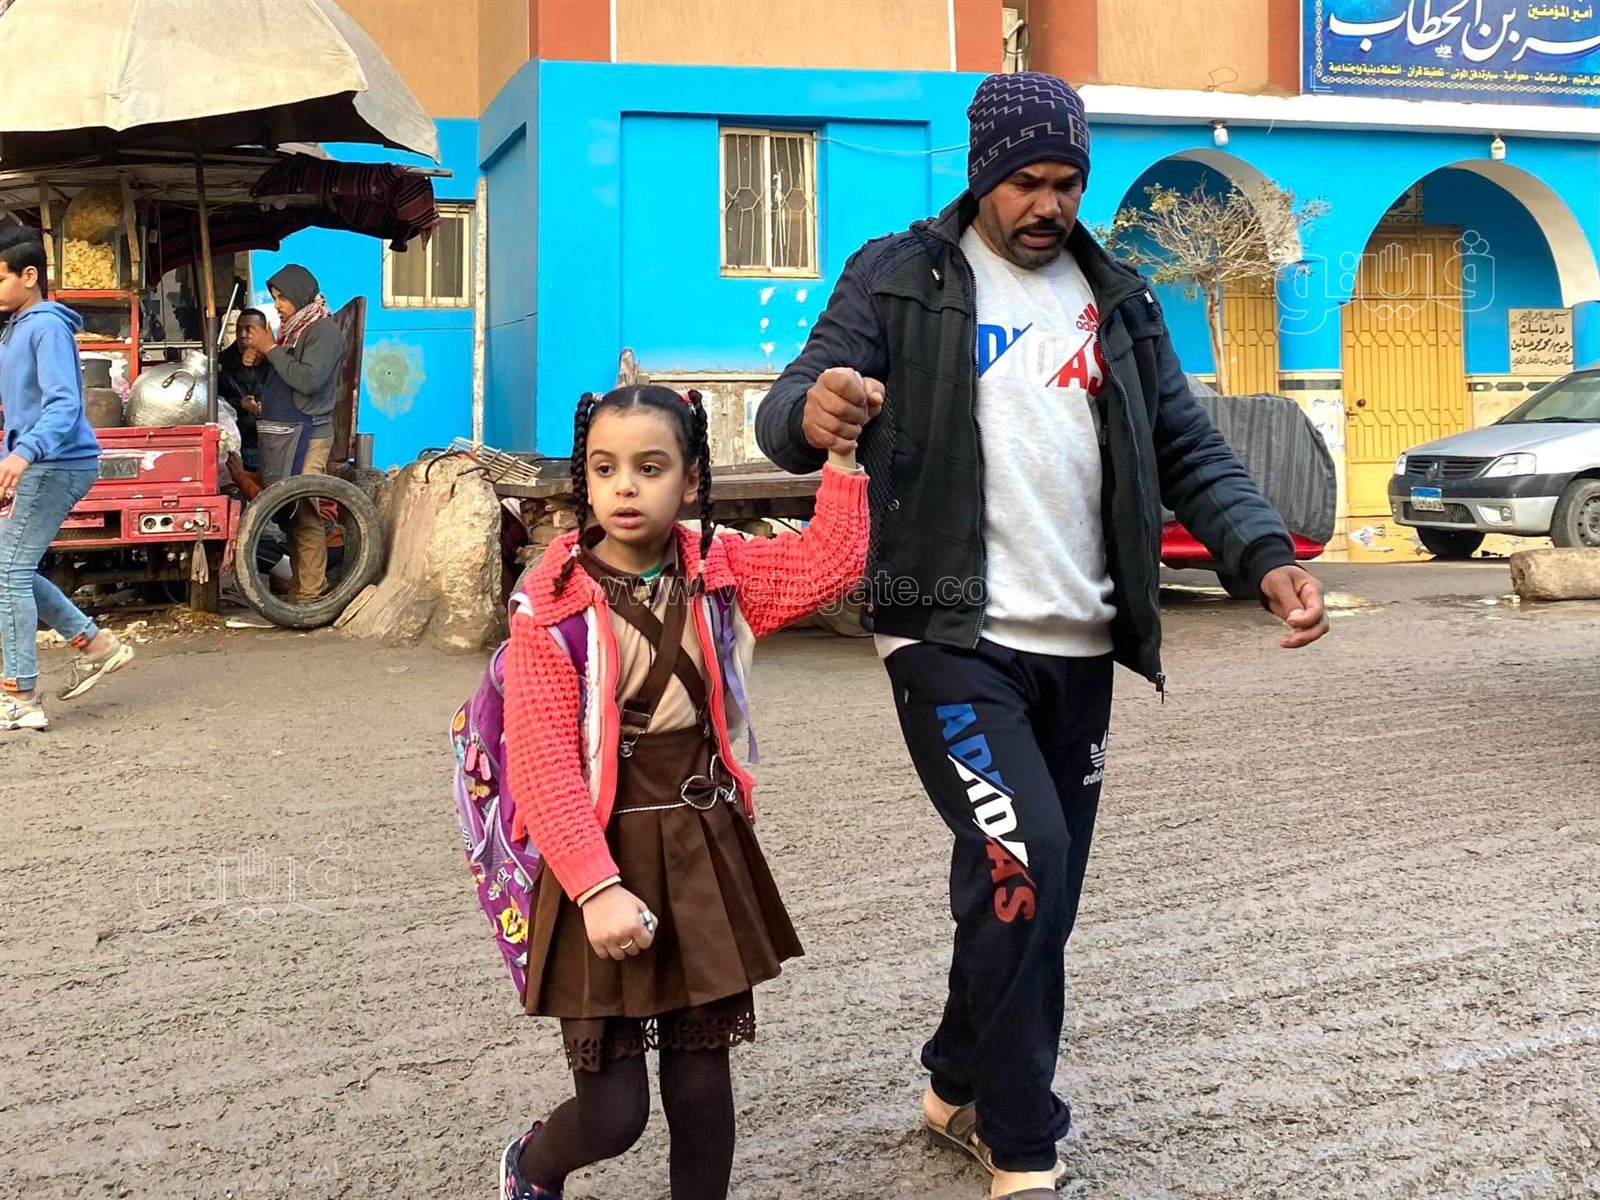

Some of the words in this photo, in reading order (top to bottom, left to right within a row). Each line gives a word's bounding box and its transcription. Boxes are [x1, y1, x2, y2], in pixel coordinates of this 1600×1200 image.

[1527, 3, 1570, 20] المؤمنين
[1570, 5, 1593, 23] أمير
[936, 703, 1036, 923] ADIDAS
